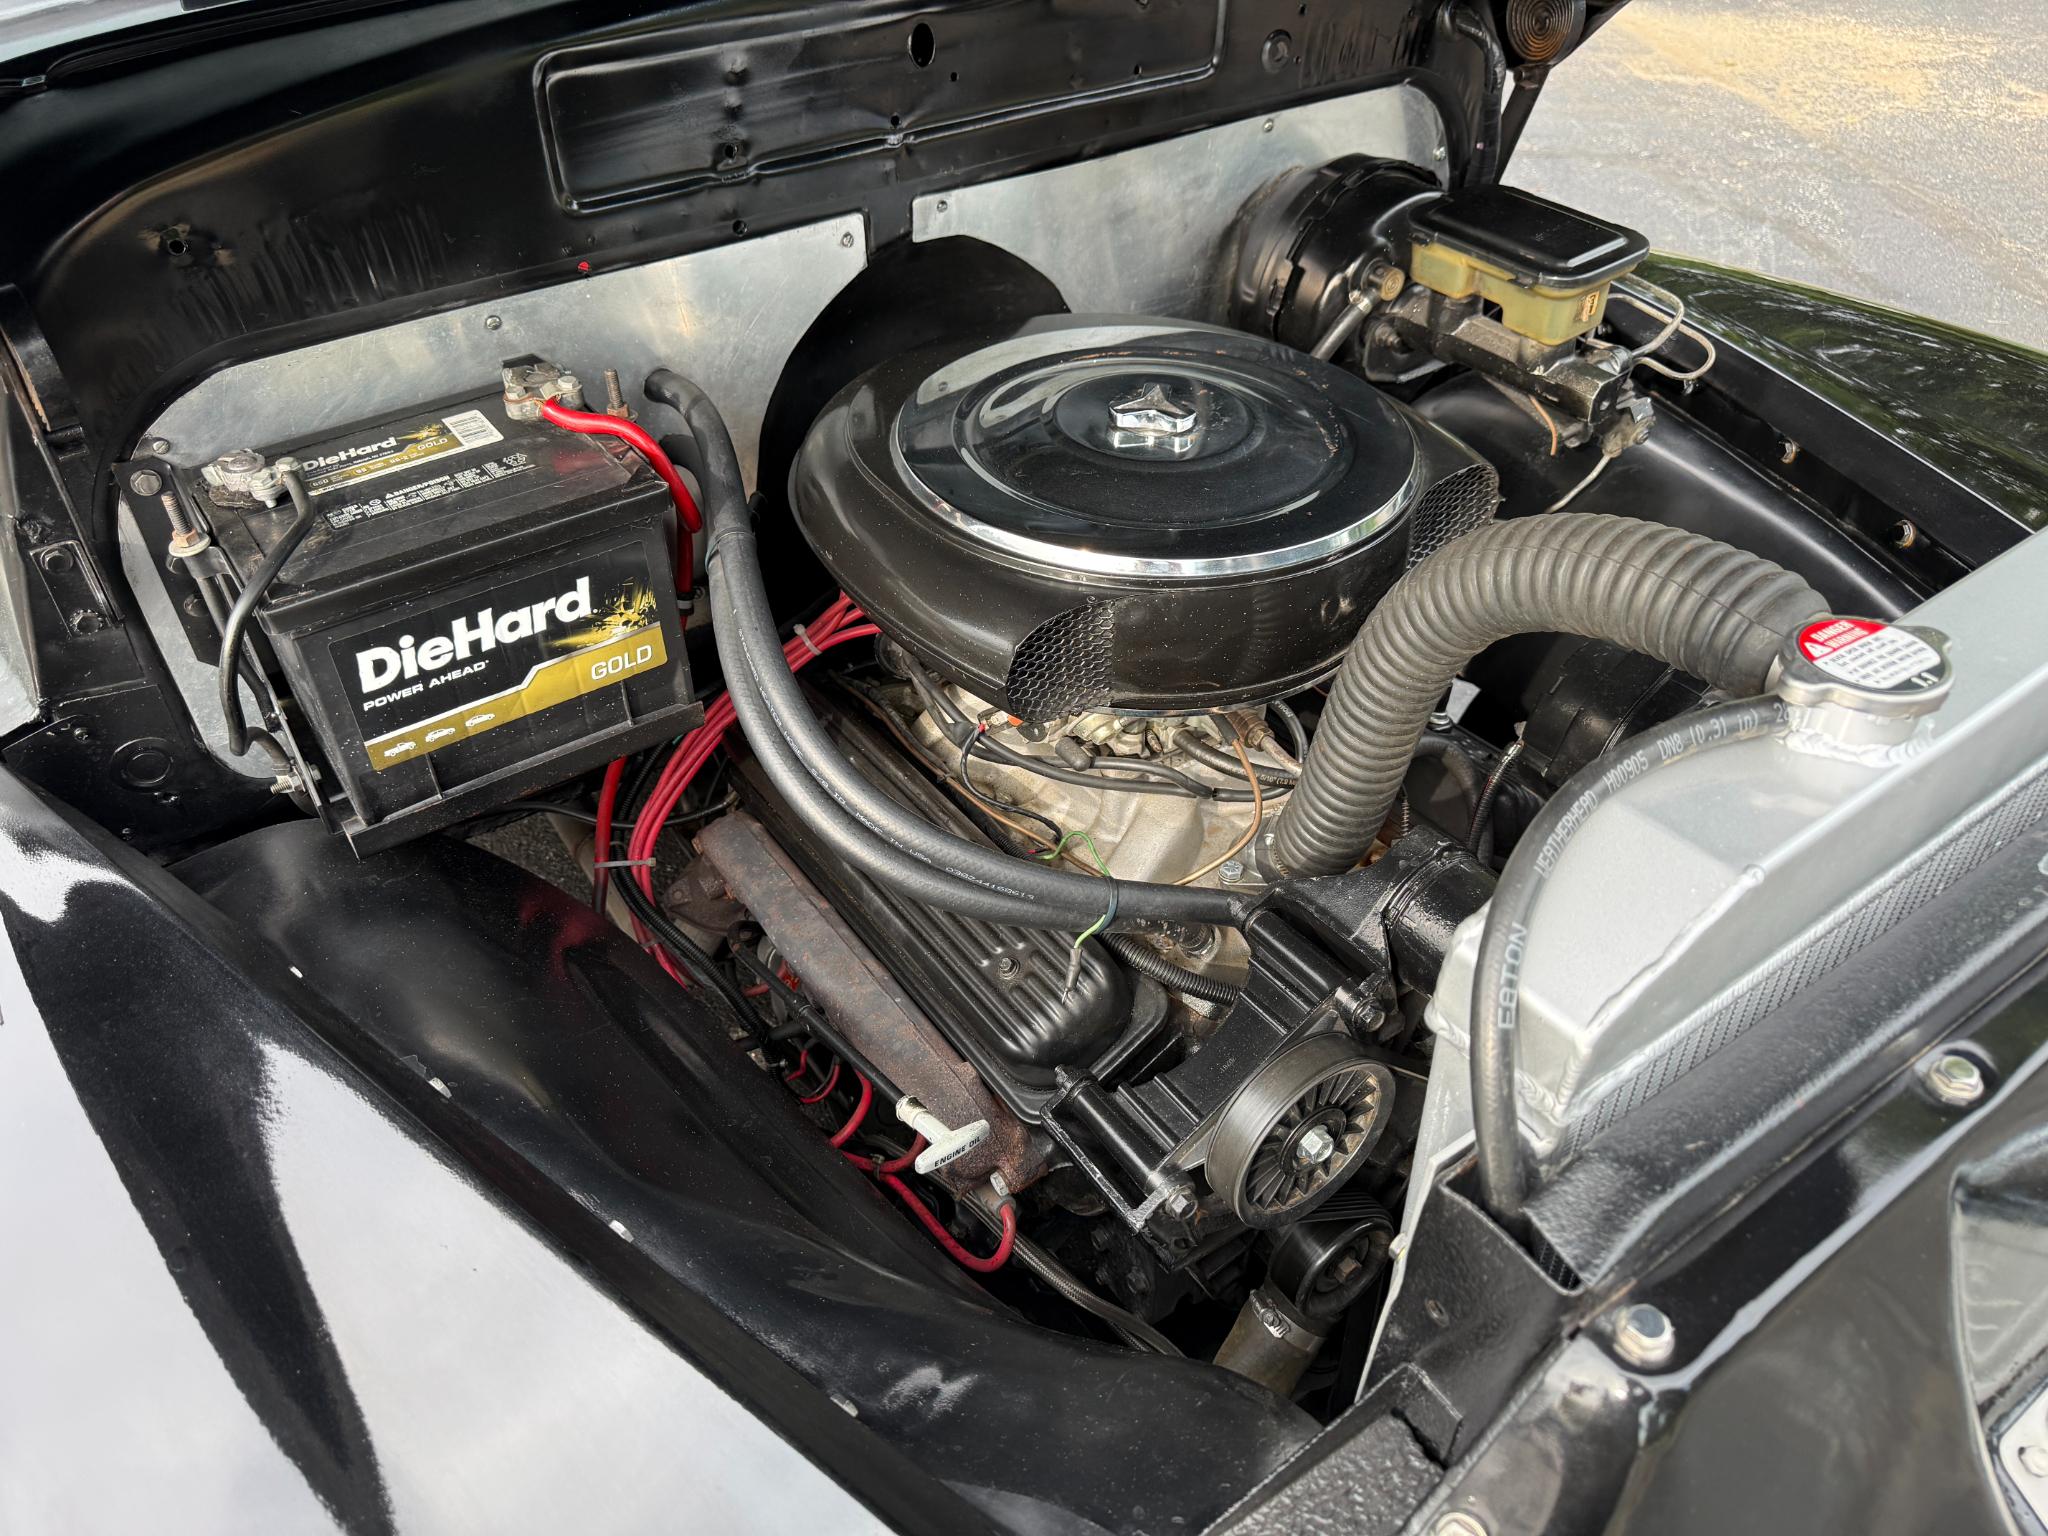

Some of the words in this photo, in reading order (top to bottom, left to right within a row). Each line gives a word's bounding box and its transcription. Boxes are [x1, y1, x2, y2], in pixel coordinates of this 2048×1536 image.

[302, 437, 398, 472] DieHard
[417, 437, 448, 451] GOLD
[355, 576, 592, 694] DieHard
[1810, 620, 1855, 642] DANGER
[1823, 628, 1870, 649] WARNING
[590, 644, 653, 682] GOLD
[1911, 671, 1939, 688] 1.1
[363, 683, 425, 712] POWER
[429, 660, 488, 689] AHEAD
[810, 768, 829, 789] 5/8
[832, 791, 847, 805] ID
[855, 812, 883, 835] MADE
[889, 837, 904, 848] IN
[909, 848, 932, 864] USA
[1498, 921, 1528, 1029] EATON
[1533, 790, 1599, 880] WEATHERHEAD
[1656, 730, 1685, 760] DN8
[1690, 718, 1727, 746] (0.31
[1737, 708, 1759, 733] in)
[934, 1145, 966, 1168] ENGINE
[968, 1136, 981, 1148] OIL
